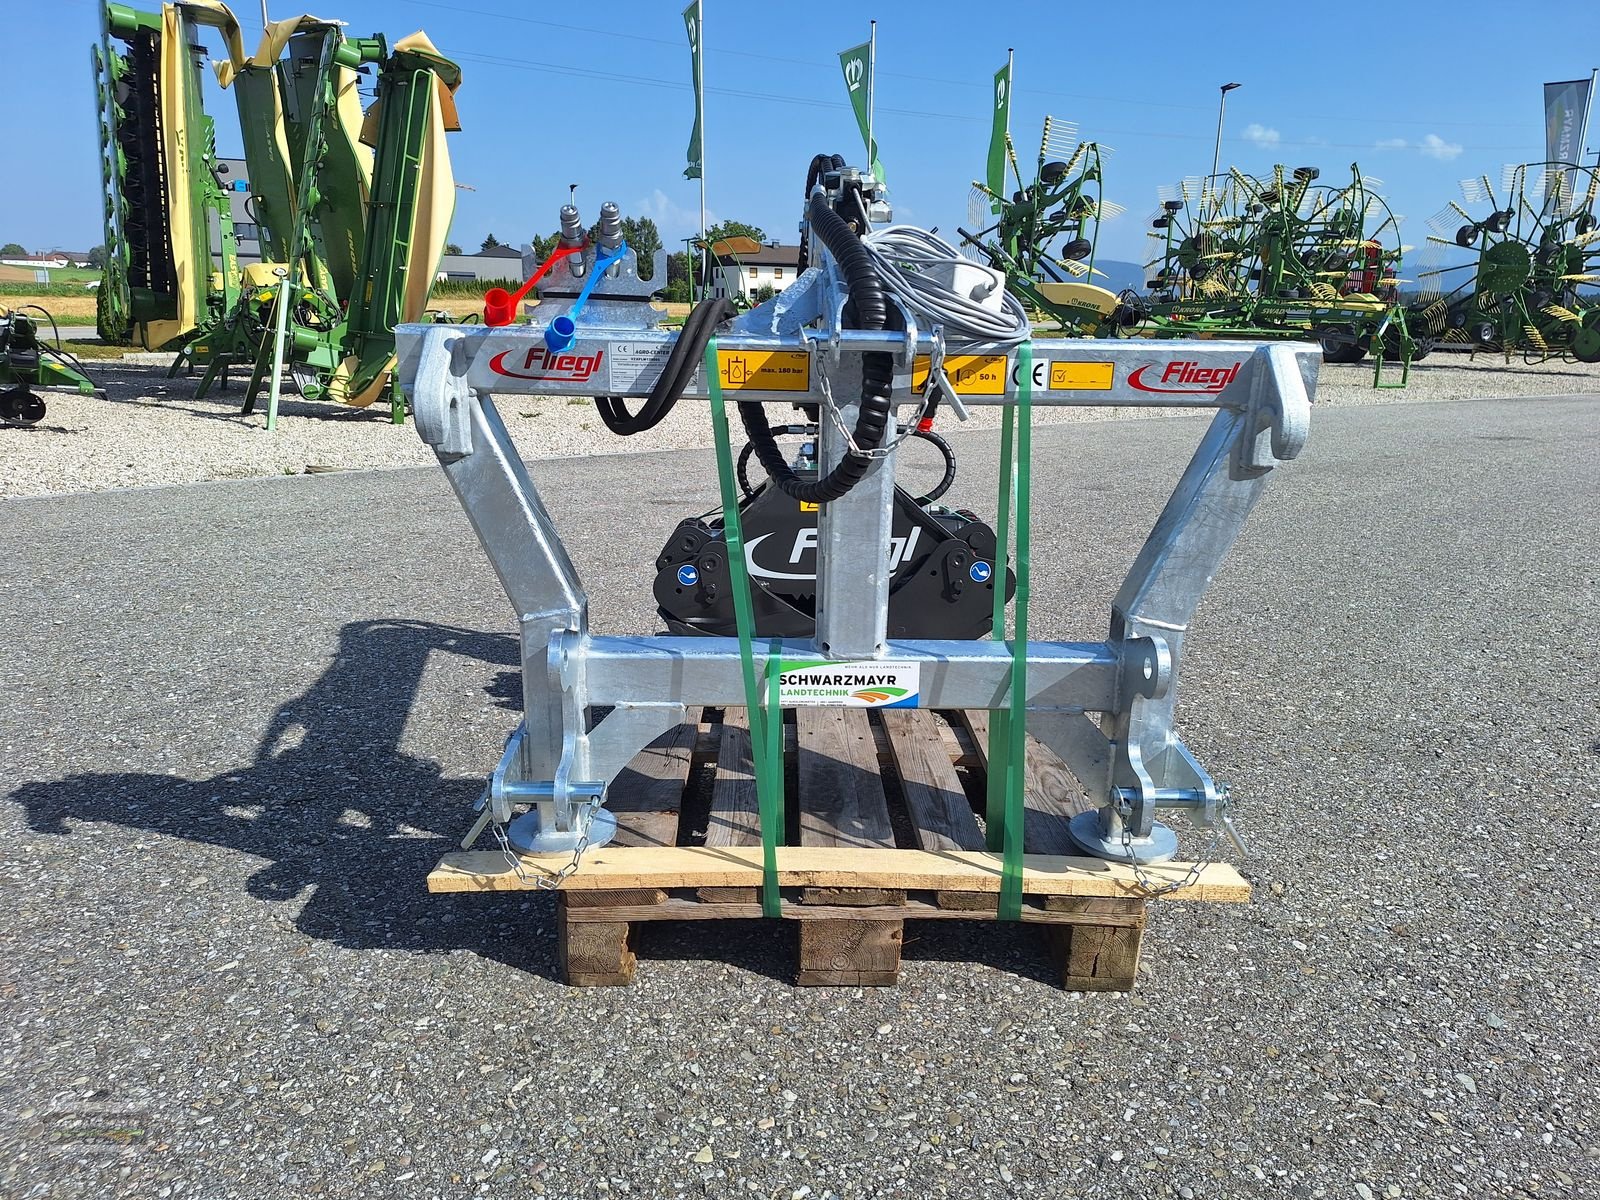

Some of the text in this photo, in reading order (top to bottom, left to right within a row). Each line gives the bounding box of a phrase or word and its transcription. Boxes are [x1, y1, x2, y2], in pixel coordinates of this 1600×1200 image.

[1077, 300, 1101, 311] KRONE
[523, 347, 604, 377] Fliegl
[1160, 361, 1241, 389] Fliegl
[779, 674, 896, 686] SCHWARZMAYR
[780, 688, 849, 697] LANDTECHNIK
